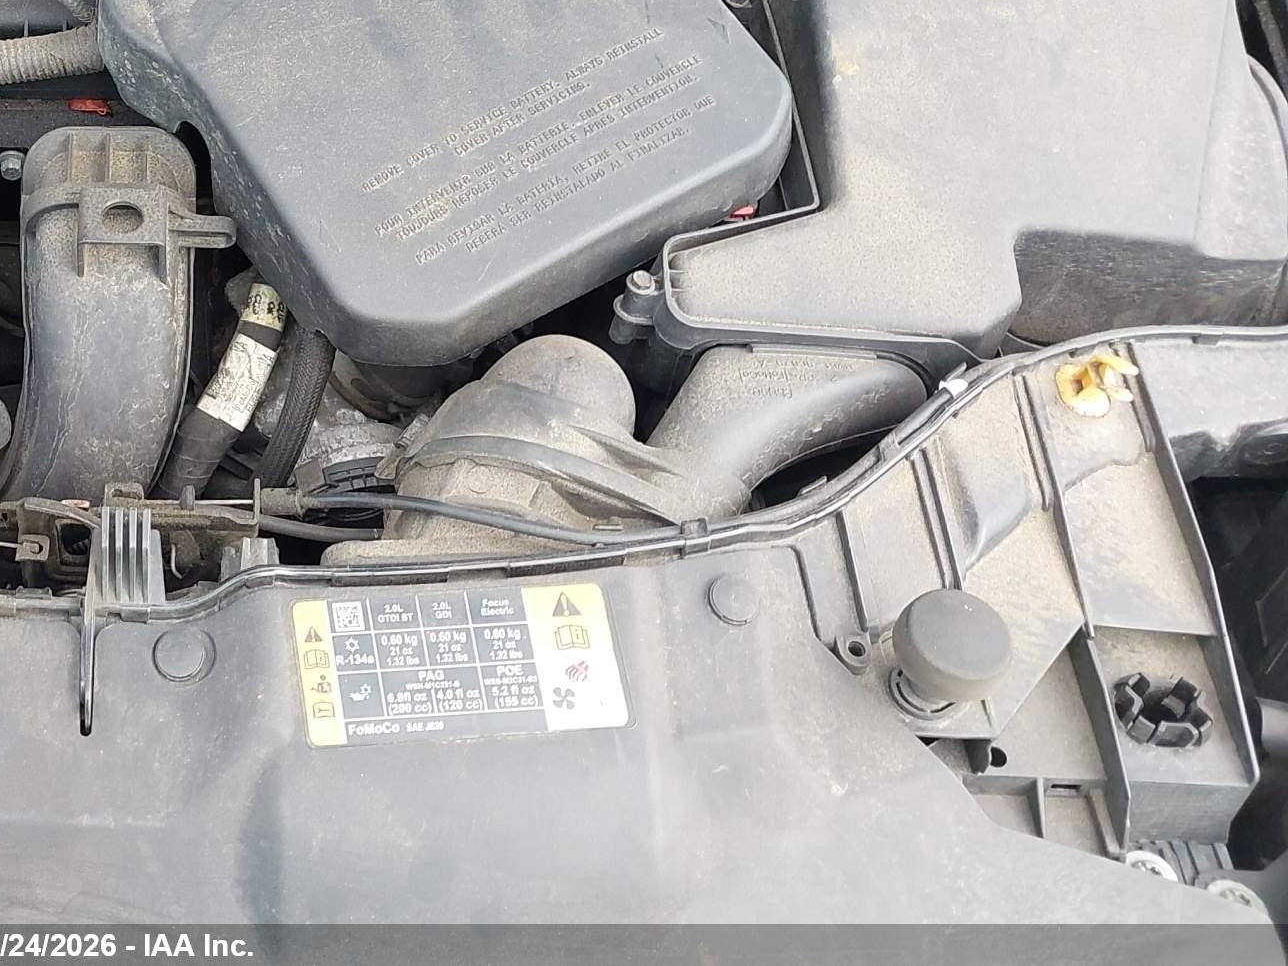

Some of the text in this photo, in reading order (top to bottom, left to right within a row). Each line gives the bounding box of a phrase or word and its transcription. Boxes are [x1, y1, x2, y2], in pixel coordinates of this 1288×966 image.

[361, 164, 404, 194] REMOVE
[406, 144, 440, 168] COVER
[460, 106, 508, 136] SERVICE
[606, 28, 665, 61] REINSTALL
[454, 133, 491, 156] COVER
[492, 112, 526, 137] AFTER
[415, 242, 446, 265] PARA
[633, 107, 693, 142] PROTECTOR
[375, 213, 404, 237] POUR
[432, 602, 452, 611] 2.0L
[482, 598, 509, 607] Focus
[384, 604, 404, 613] 2.0L
[480, 607, 515, 616] Electric
[377, 613, 414, 623] GTDI ST
[435, 610, 452, 619] GDI
[381, 634, 418, 646] 0.60 kg
[429, 631, 467, 644] 0.60 kg
[483, 628, 521, 641] 0.60 kg
[438, 644, 463, 653] 21 oz
[492, 641, 516, 650] 21 oz
[390, 647, 400, 656] 21
[509, 650, 523, 659] lbs
[335, 654, 375, 666] R-134a
[406, 656, 420, 666] lbs
[455, 653, 469, 662] lbs
[418, 670, 444, 681] PAG
[496, 665, 524, 677] POE
[437, 689, 454, 700] 4.0
[466, 690, 481, 699] oz
[492, 685, 509, 697] 5.2
[521, 685, 535, 694] oz
[413, 692, 428, 702] oz
[521, 695, 539, 707] cc)
[414, 701, 433, 714] cc)
[439, 698, 483, 713] (120 cc)
[348, 721, 400, 736] FoMoCo
